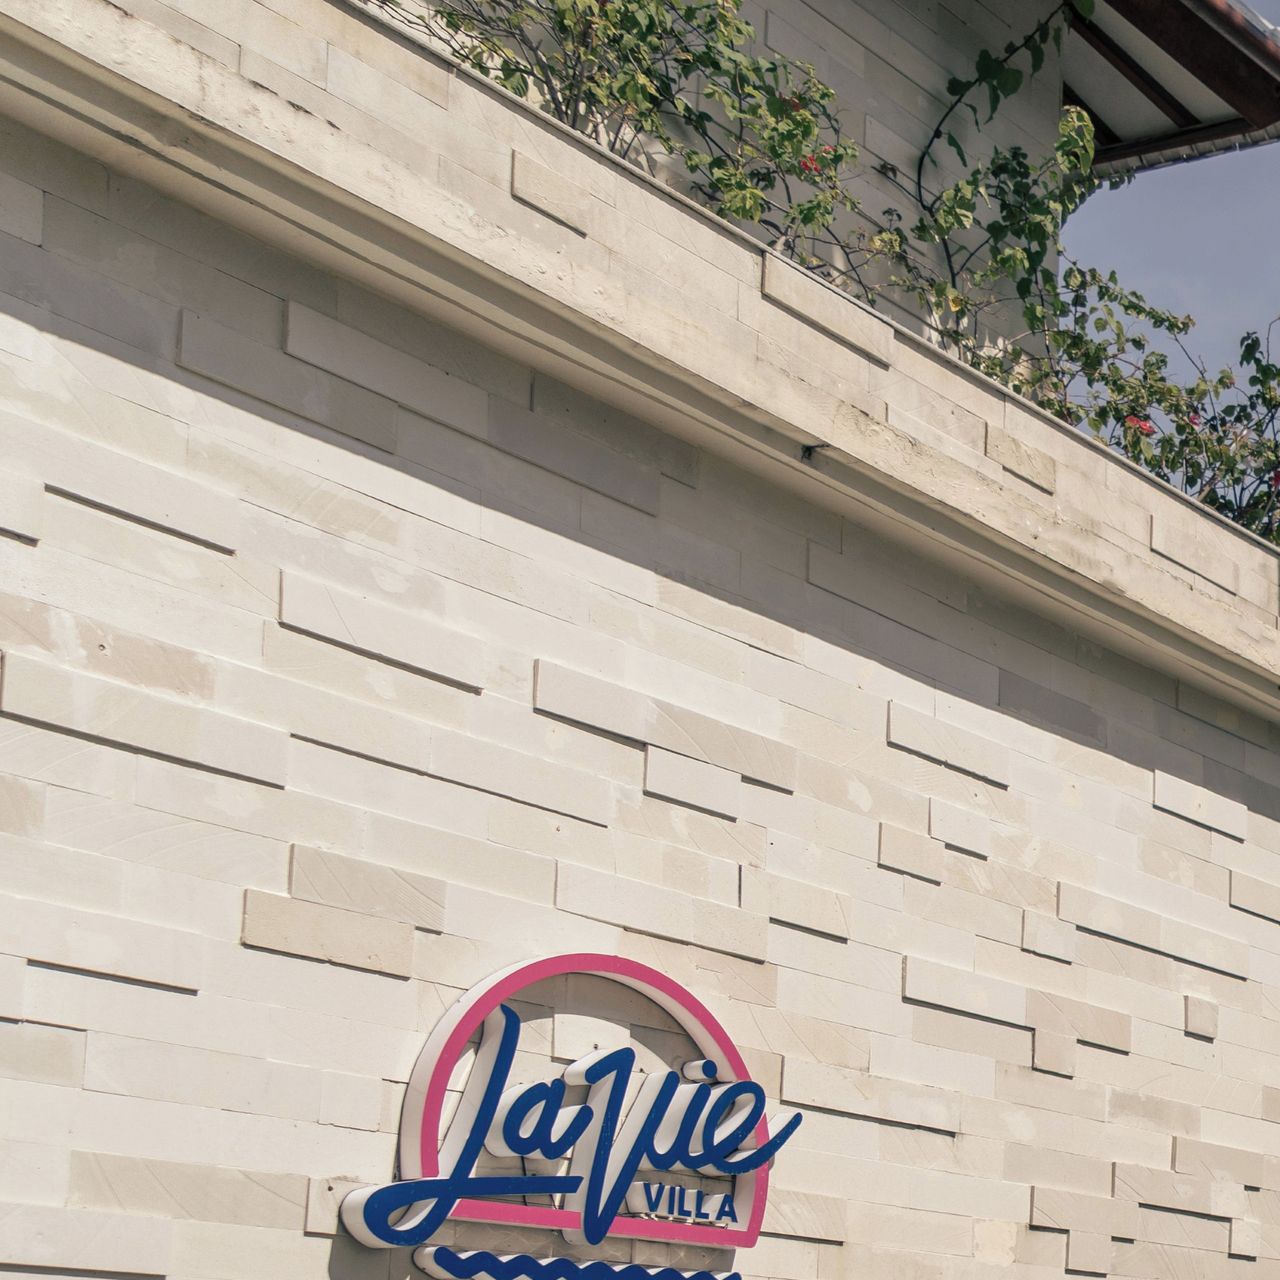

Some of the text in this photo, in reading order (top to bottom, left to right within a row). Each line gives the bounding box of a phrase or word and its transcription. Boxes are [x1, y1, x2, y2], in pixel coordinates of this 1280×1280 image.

[364, 1004, 803, 1246] La Vie
[643, 1182, 738, 1224] VILLA
